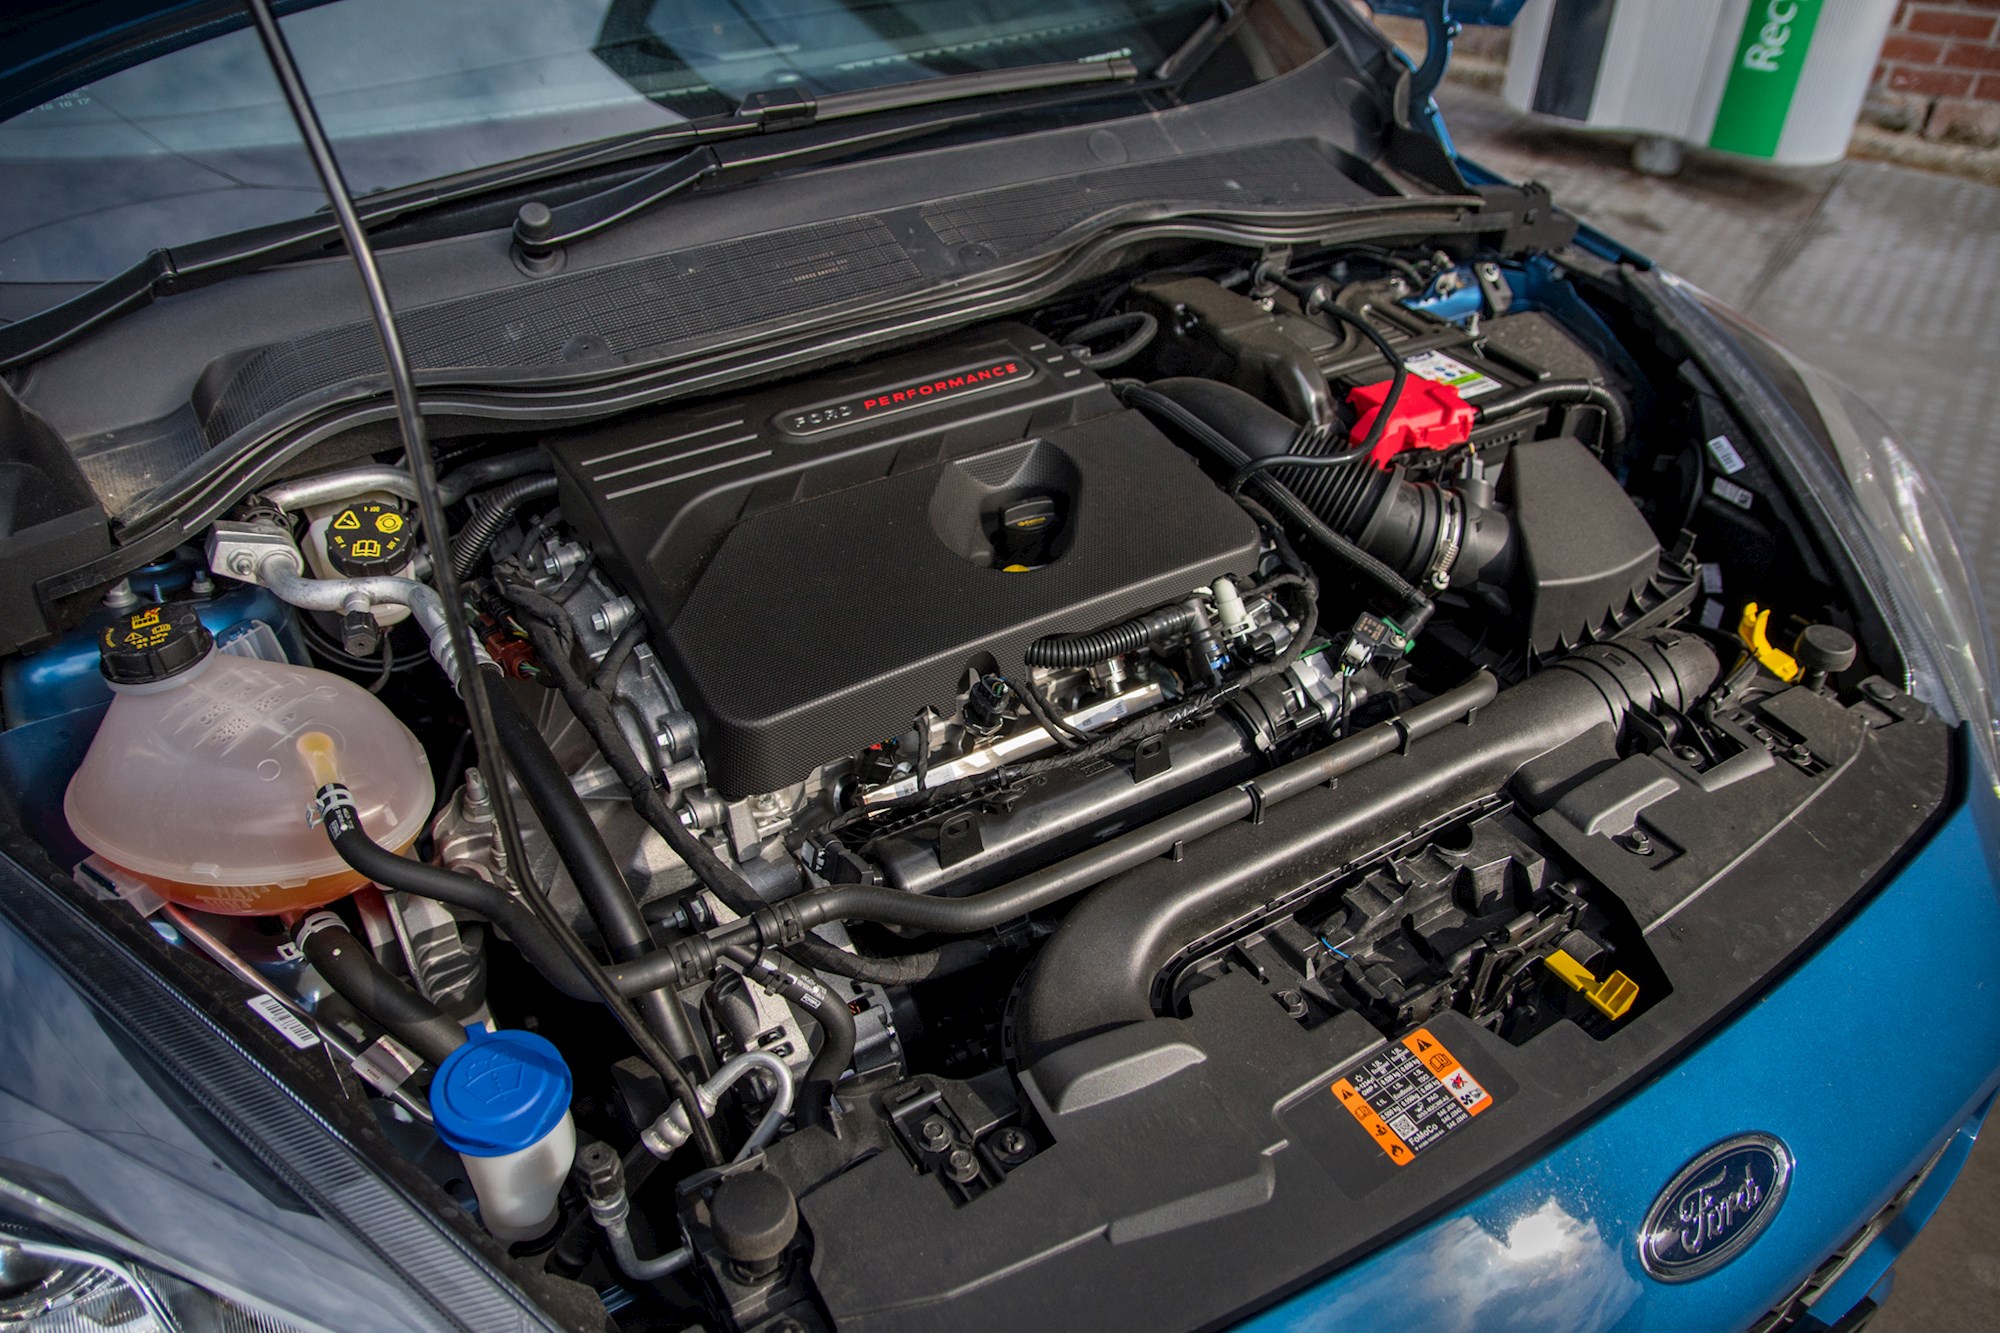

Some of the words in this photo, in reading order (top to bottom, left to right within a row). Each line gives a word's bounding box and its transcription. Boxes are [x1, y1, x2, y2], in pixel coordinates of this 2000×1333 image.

[794, 405, 853, 428] FORD
[863, 362, 1019, 410] PERFORMANCE
[1408, 1122, 1439, 1146] FoMoCo
[1680, 1163, 1763, 1254] Ford
